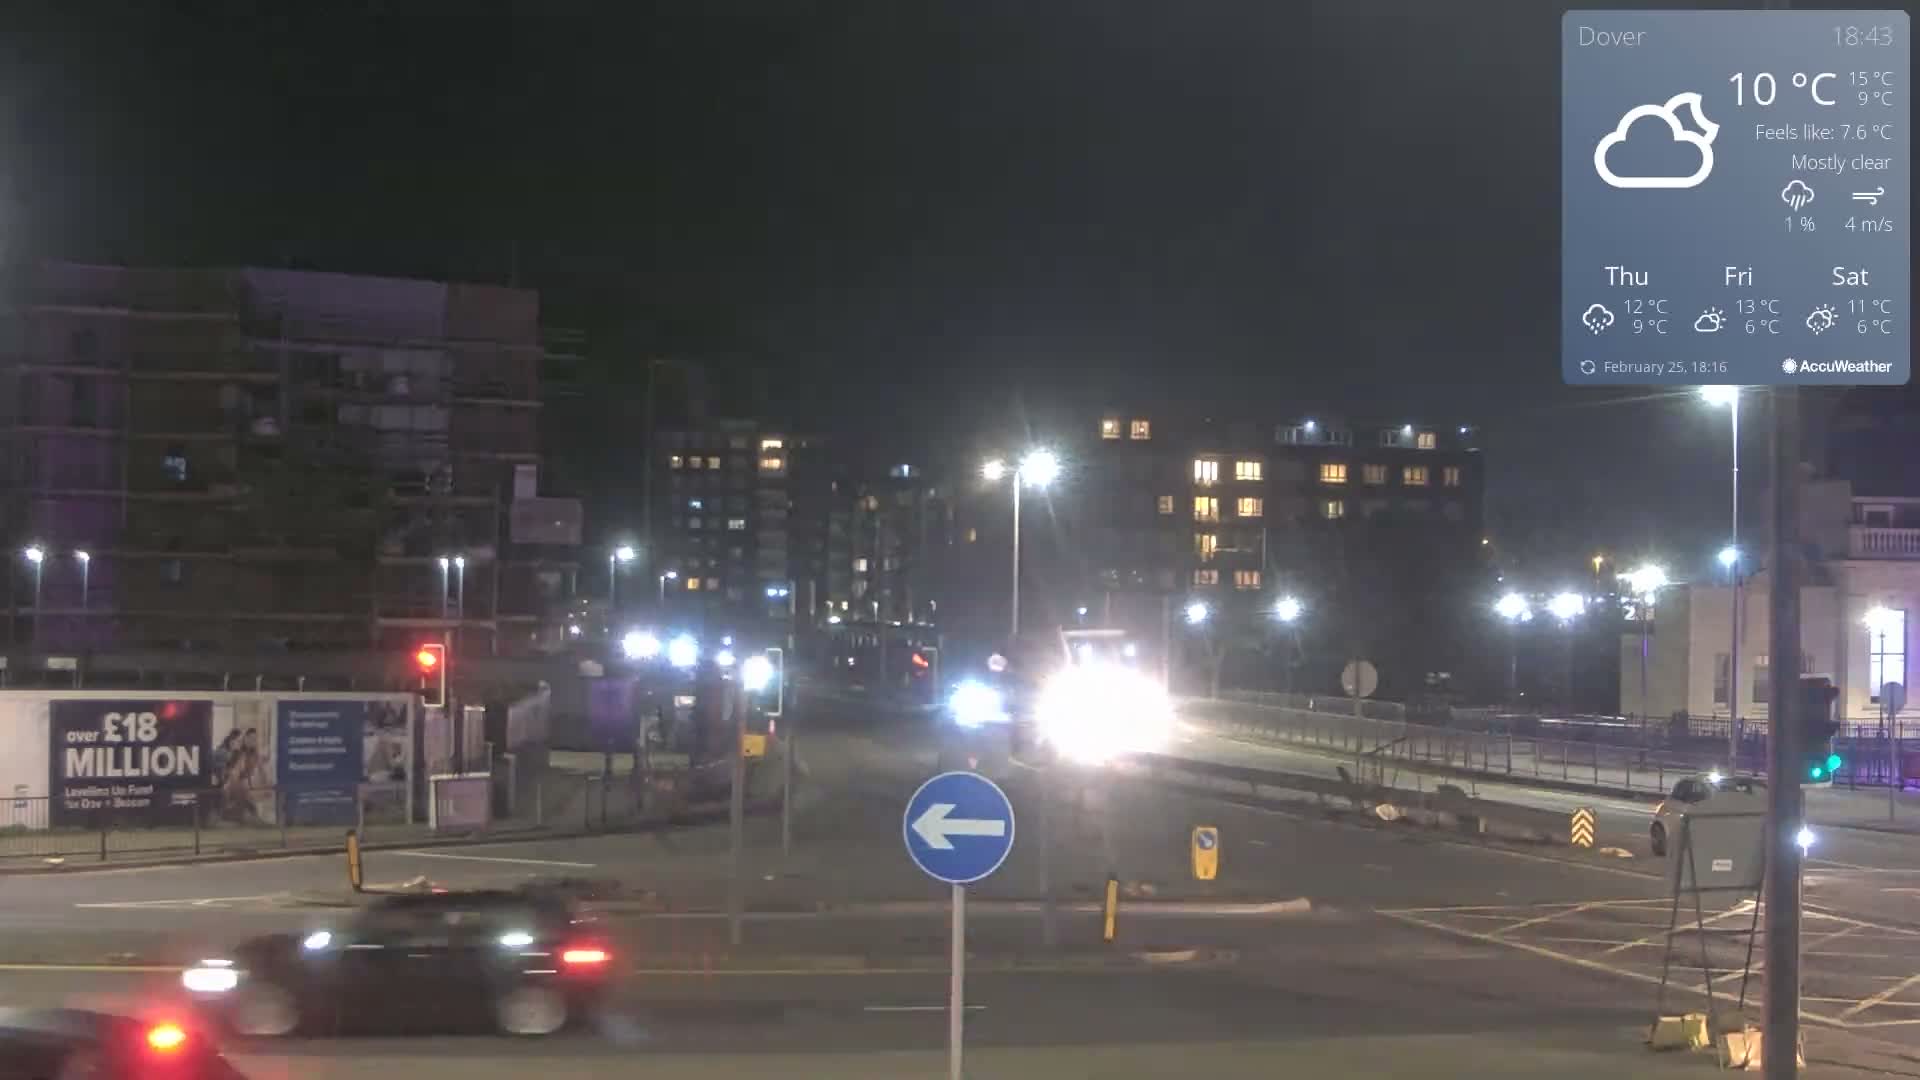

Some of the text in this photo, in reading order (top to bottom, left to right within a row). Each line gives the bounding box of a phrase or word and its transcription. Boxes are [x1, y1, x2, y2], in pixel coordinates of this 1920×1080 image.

[66, 712, 158, 743] over £18
[65, 746, 200, 778] MILLION
